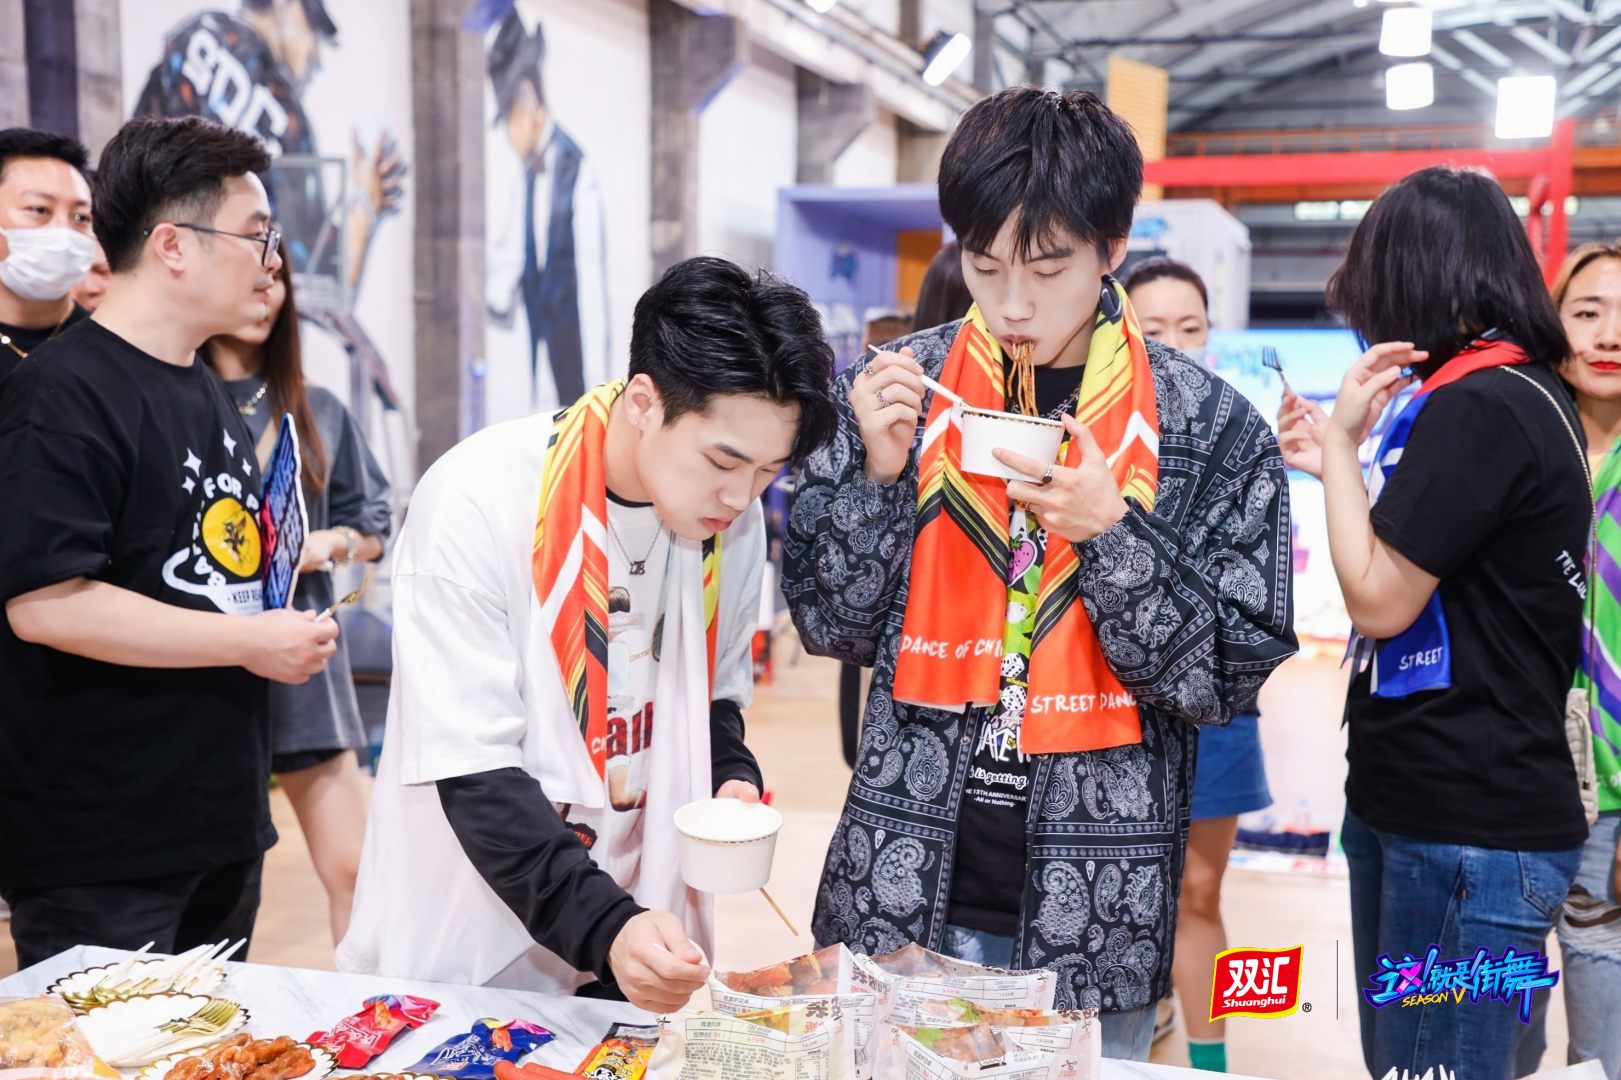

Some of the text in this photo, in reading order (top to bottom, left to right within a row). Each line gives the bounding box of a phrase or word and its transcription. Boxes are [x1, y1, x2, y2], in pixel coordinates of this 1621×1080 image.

[203, 473, 243, 500] FOR
[1555, 549, 1576, 576] THE
[900, 634, 949, 659] DANCE
[1399, 647, 1443, 671] STREET
[1030, 693, 1096, 715] STREET
[984, 771, 1027, 790] getting
[973, 788, 989, 797] 13TH
[988, 791, 1027, 801] ANNIVERSAR
